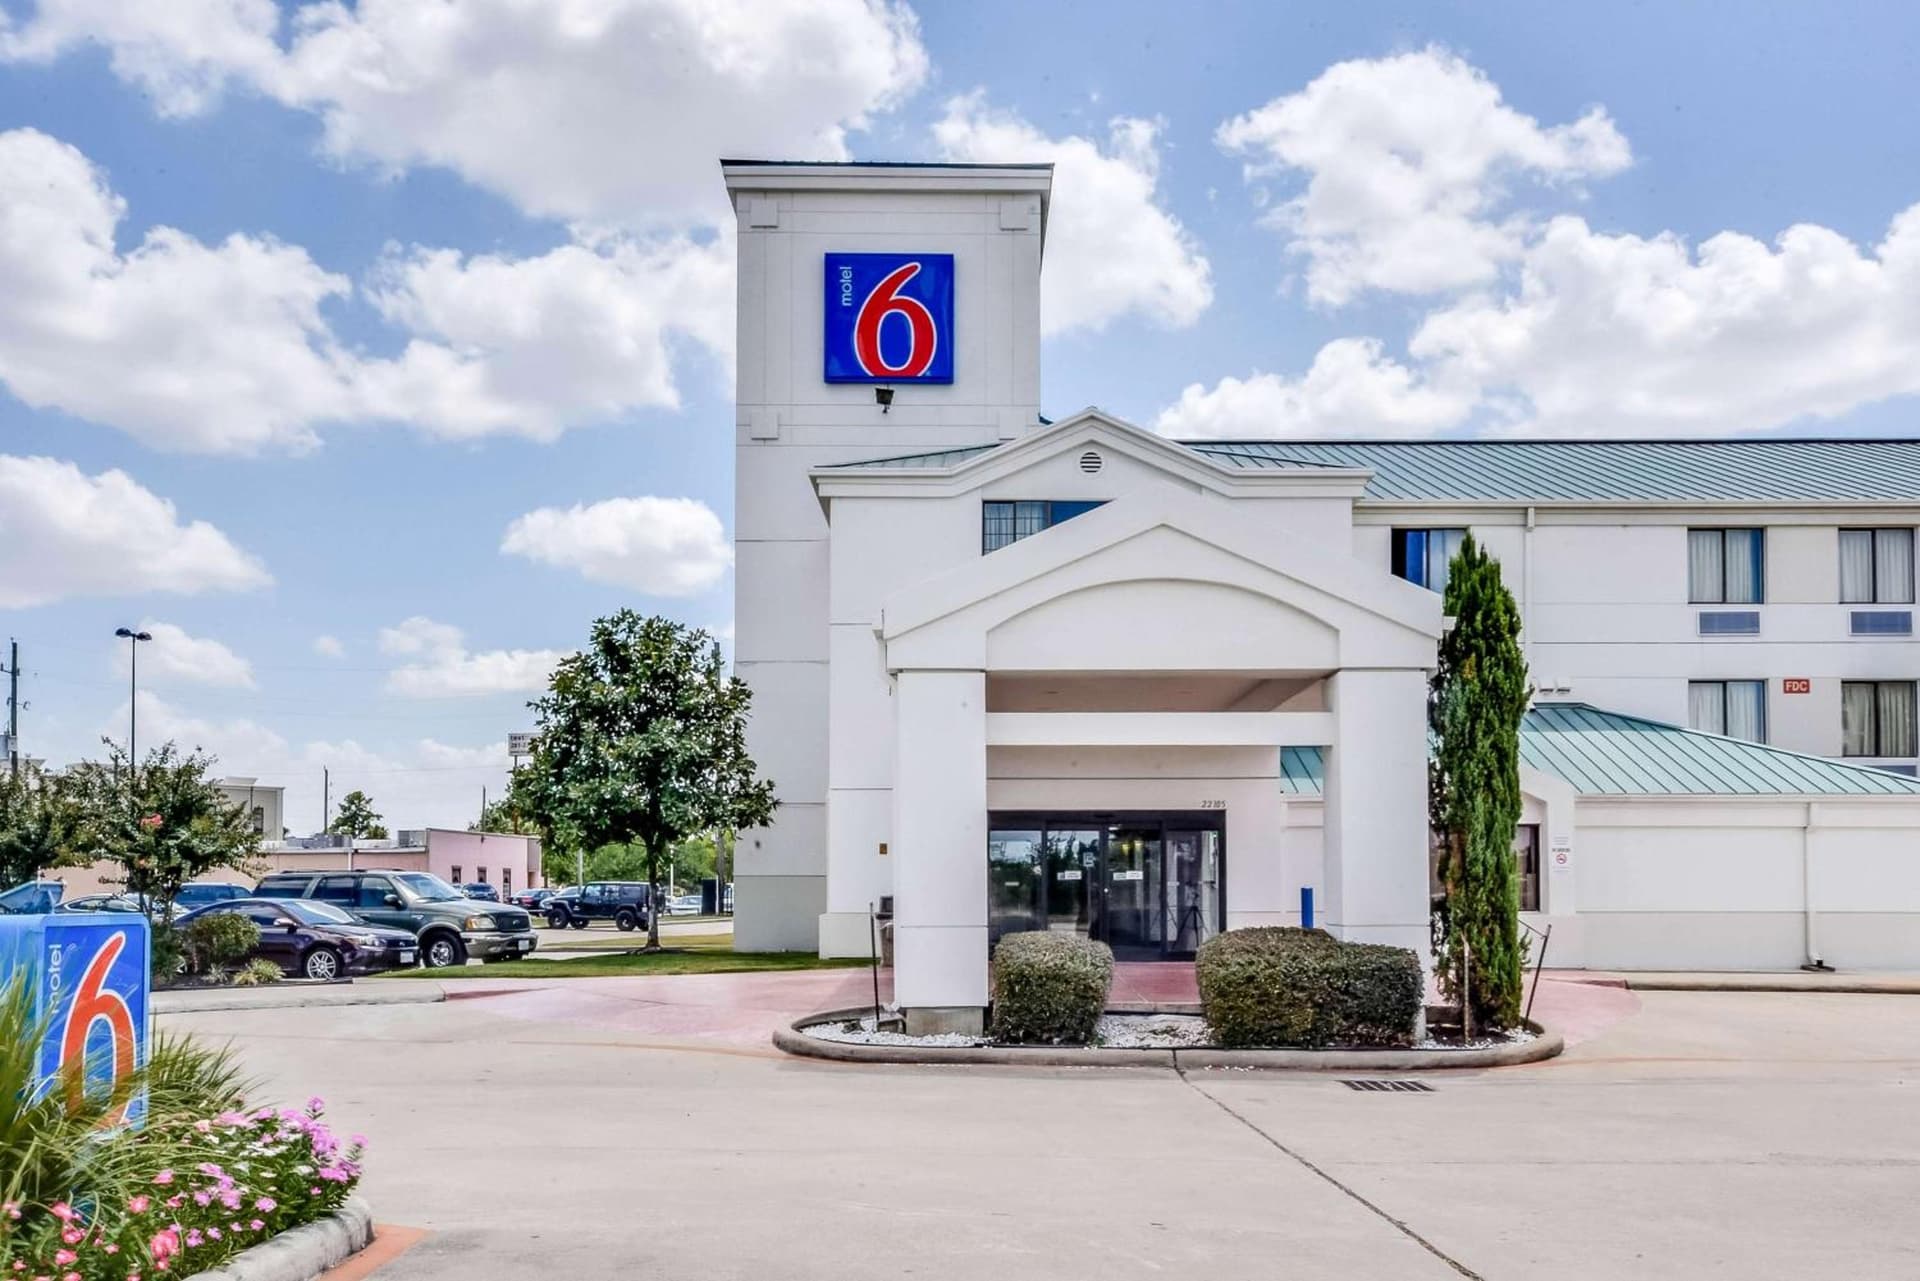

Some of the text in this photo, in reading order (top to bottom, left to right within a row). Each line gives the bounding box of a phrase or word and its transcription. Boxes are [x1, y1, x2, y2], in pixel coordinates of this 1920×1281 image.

[840, 261, 937, 377] motel 6
[1785, 681, 1808, 691] FDC
[60, 930, 136, 1128] 6
